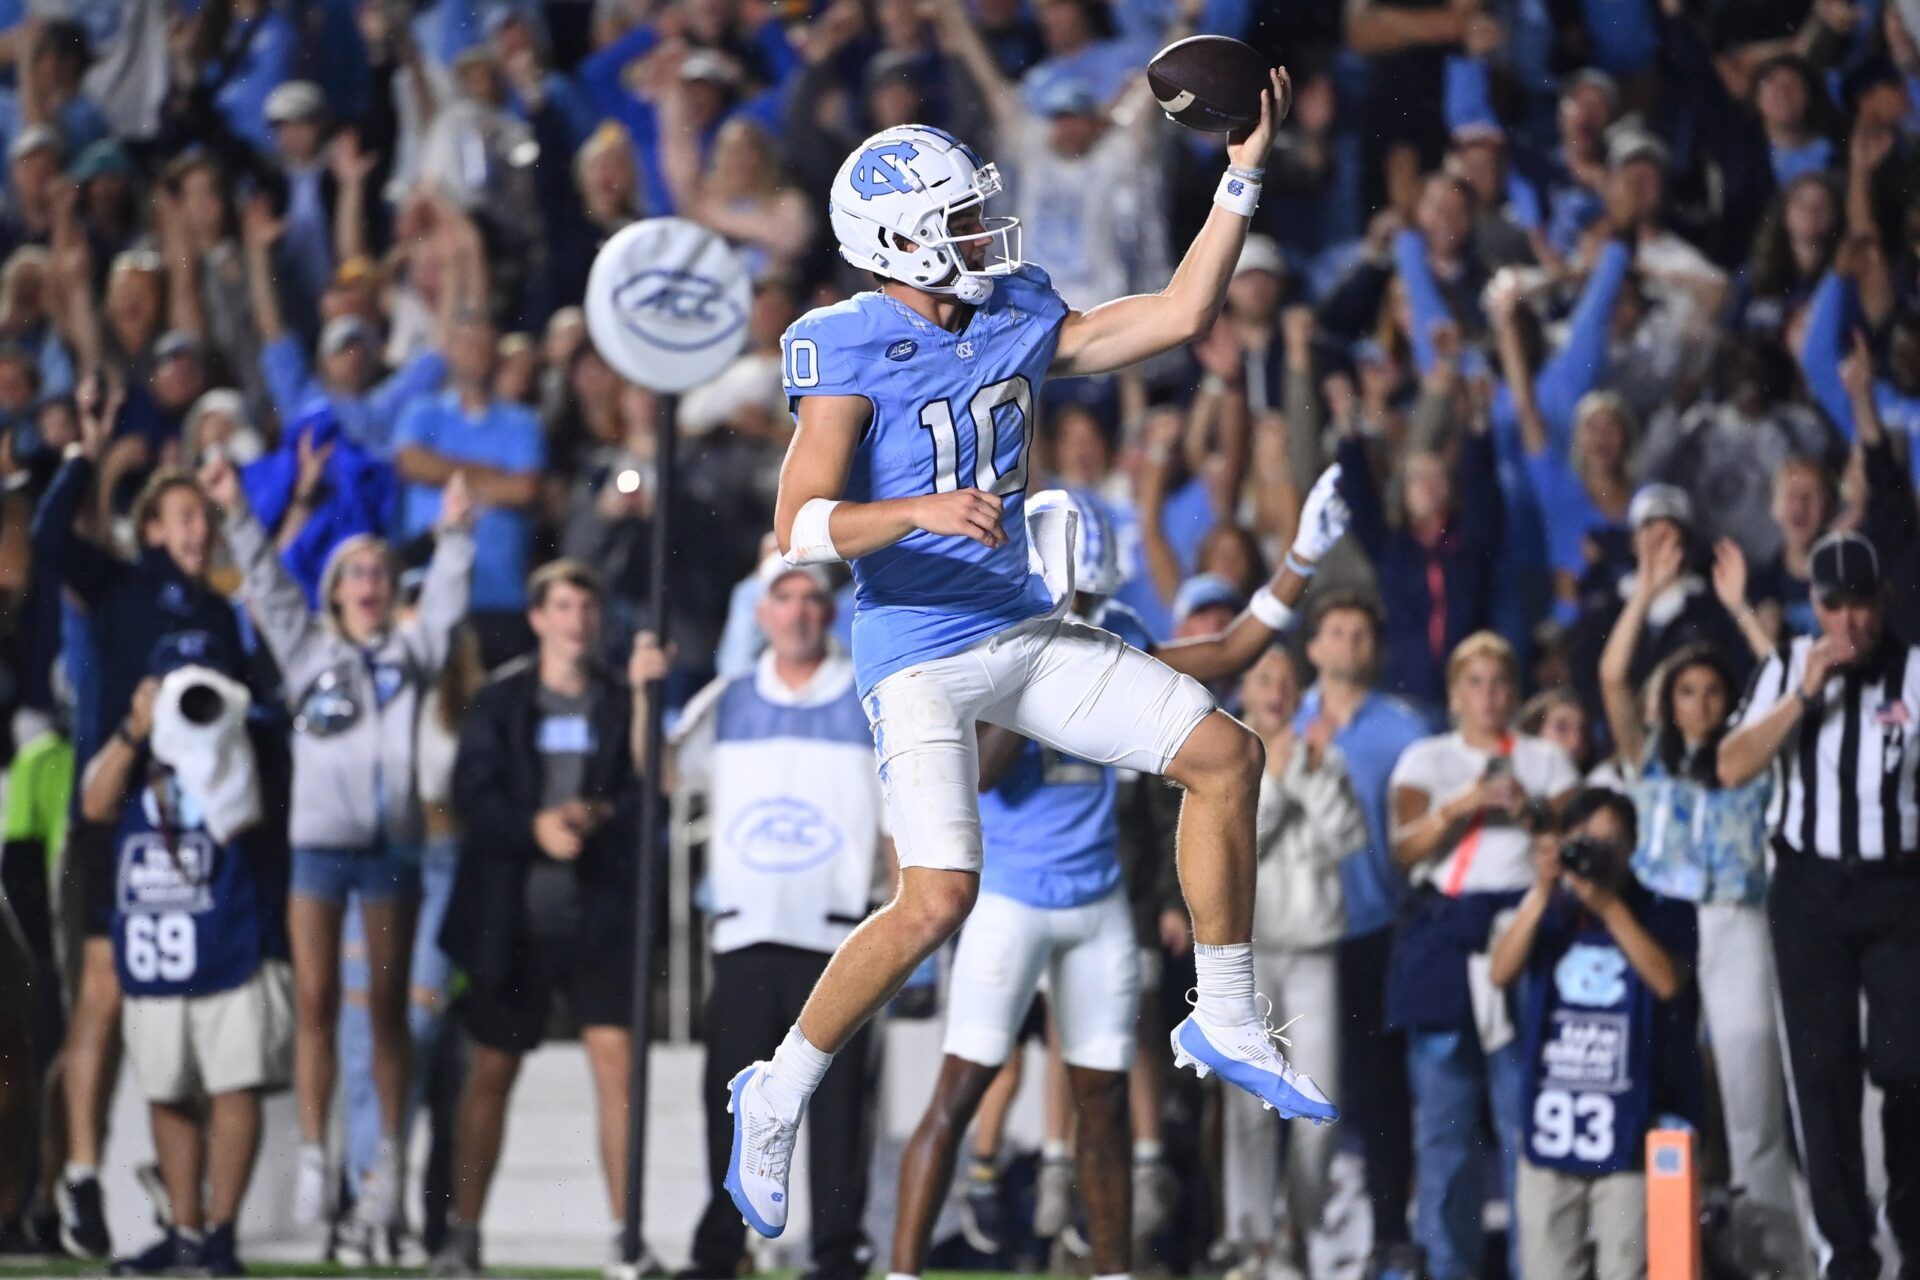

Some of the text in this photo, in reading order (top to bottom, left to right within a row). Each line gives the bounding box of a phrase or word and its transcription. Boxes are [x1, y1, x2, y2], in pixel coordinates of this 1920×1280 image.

[888, 341, 913, 359] ACC
[918, 373, 1034, 497] 10
[125, 911, 197, 983] 69
[1532, 1089, 1616, 1161] 93
